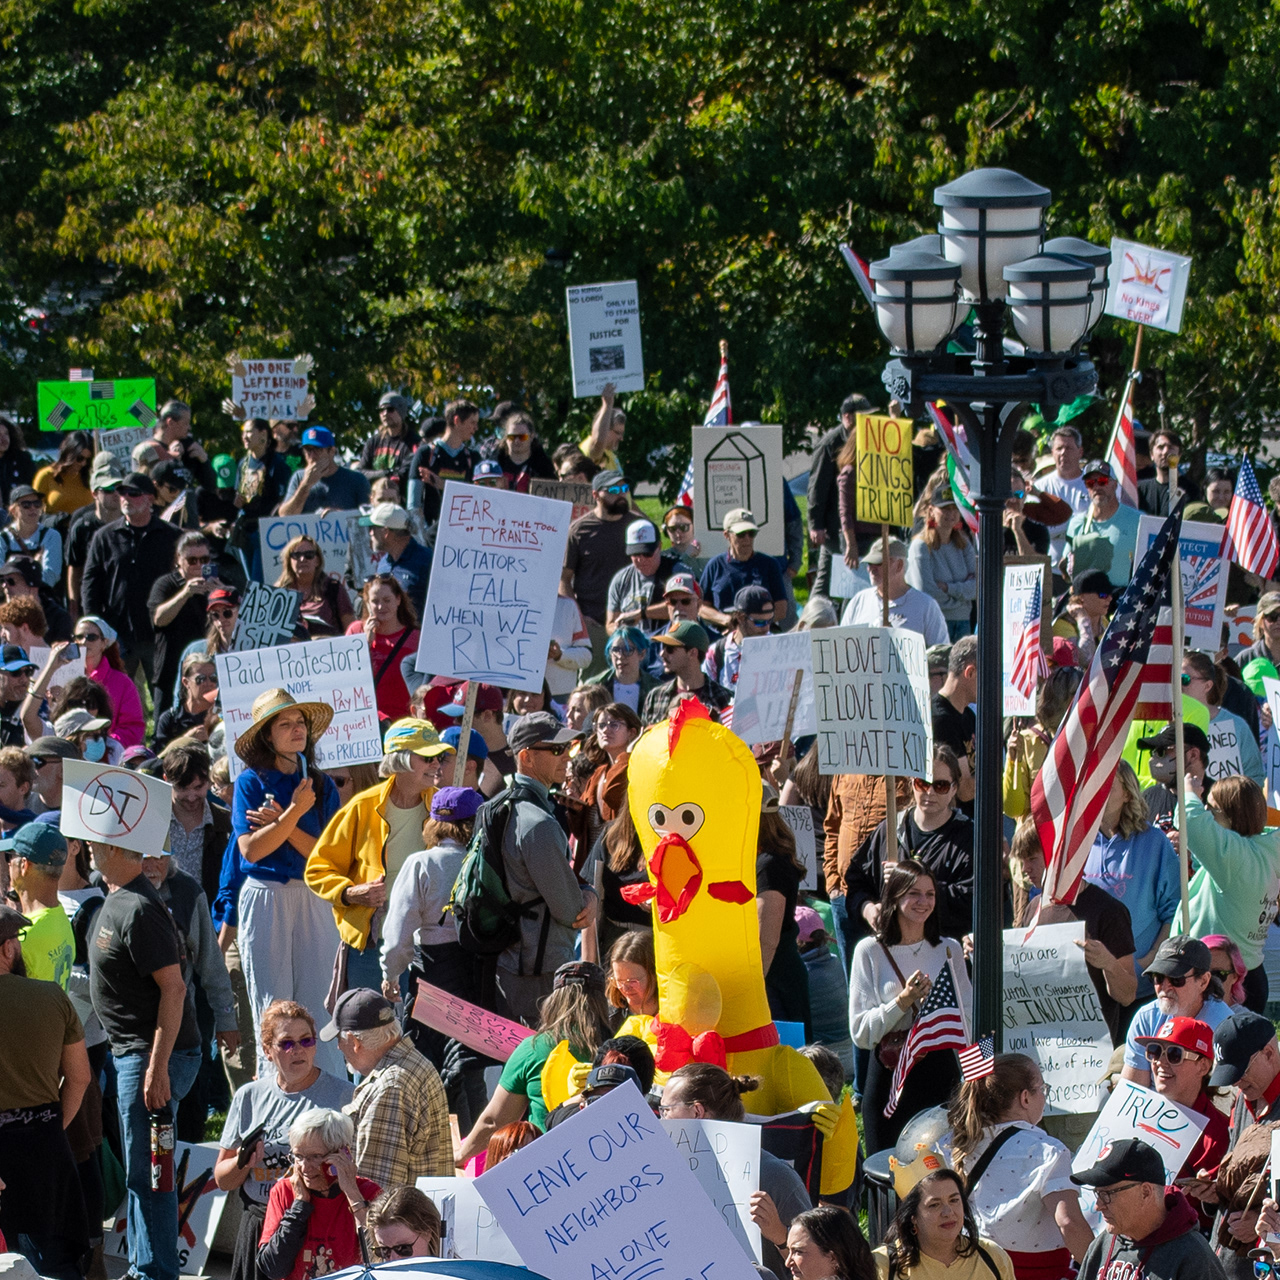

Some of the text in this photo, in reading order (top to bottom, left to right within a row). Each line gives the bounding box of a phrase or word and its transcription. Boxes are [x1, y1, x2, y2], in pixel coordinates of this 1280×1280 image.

[589, 329, 622, 340] JUSTICE
[243, 377, 306, 389] LEFT BEHIND
[249, 362, 290, 373] NO ONE
[242, 390, 292, 401] JUSTICE
[866, 418, 900, 454] NO
[858, 455, 910, 491] KINGS
[448, 495, 494, 523] FEAR
[511, 521, 531, 529] THE
[534, 522, 557, 532] TOOL
[859, 486, 912, 521] TRUMP
[442, 546, 527, 572] DICTATORS
[470, 574, 530, 603] FALL
[433, 606, 541, 635] WHEN WE
[224, 639, 365, 687] Paid Protestor?
[452, 627, 539, 673] RISE.
[815, 636, 882, 674] I LOVE
[1010, 948, 1058, 977] you are
[1025, 994, 1103, 1025] INJUSTICE
[506, 1111, 655, 1216] LEAVE OUR
[544, 1163, 664, 1255] NEIGHBORS
